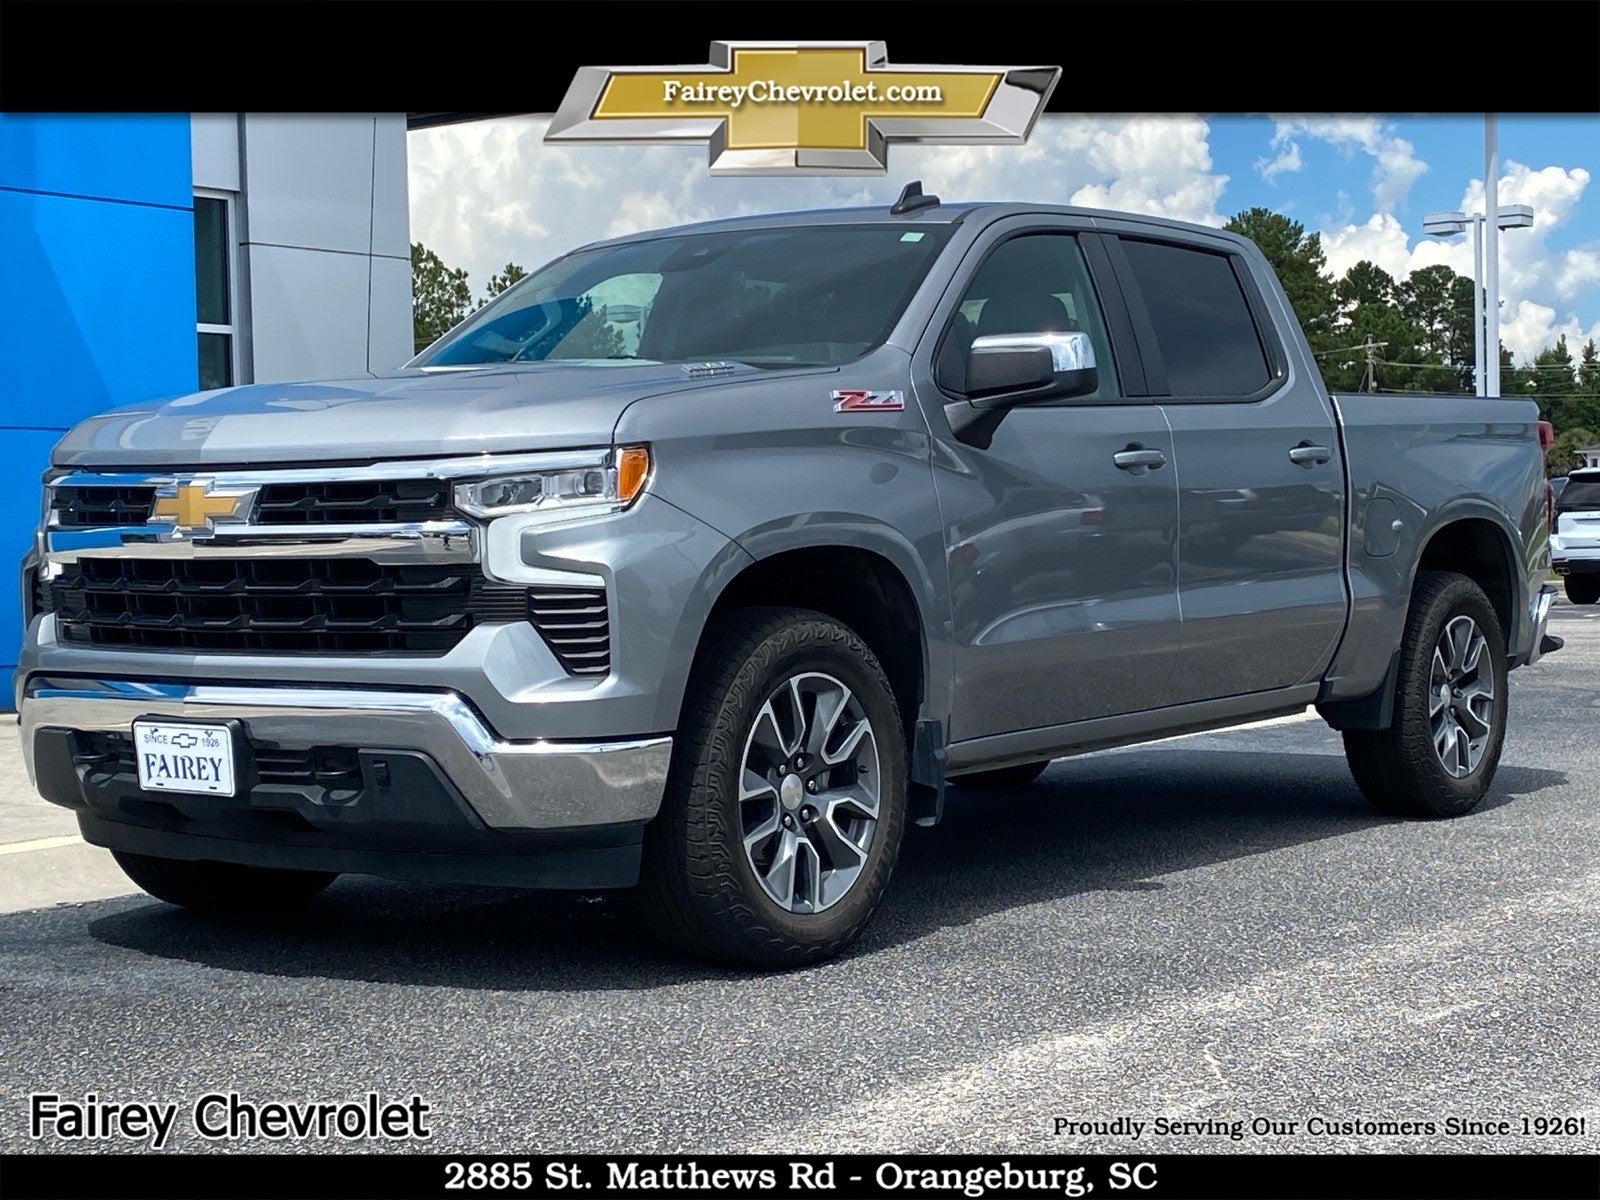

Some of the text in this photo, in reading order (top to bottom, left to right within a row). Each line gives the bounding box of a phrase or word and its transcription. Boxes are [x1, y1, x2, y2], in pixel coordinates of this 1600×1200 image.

[830, 389, 905, 413] Z71
[143, 733, 220, 748] SINCE 1926
[144, 753, 222, 782] FAIREY
